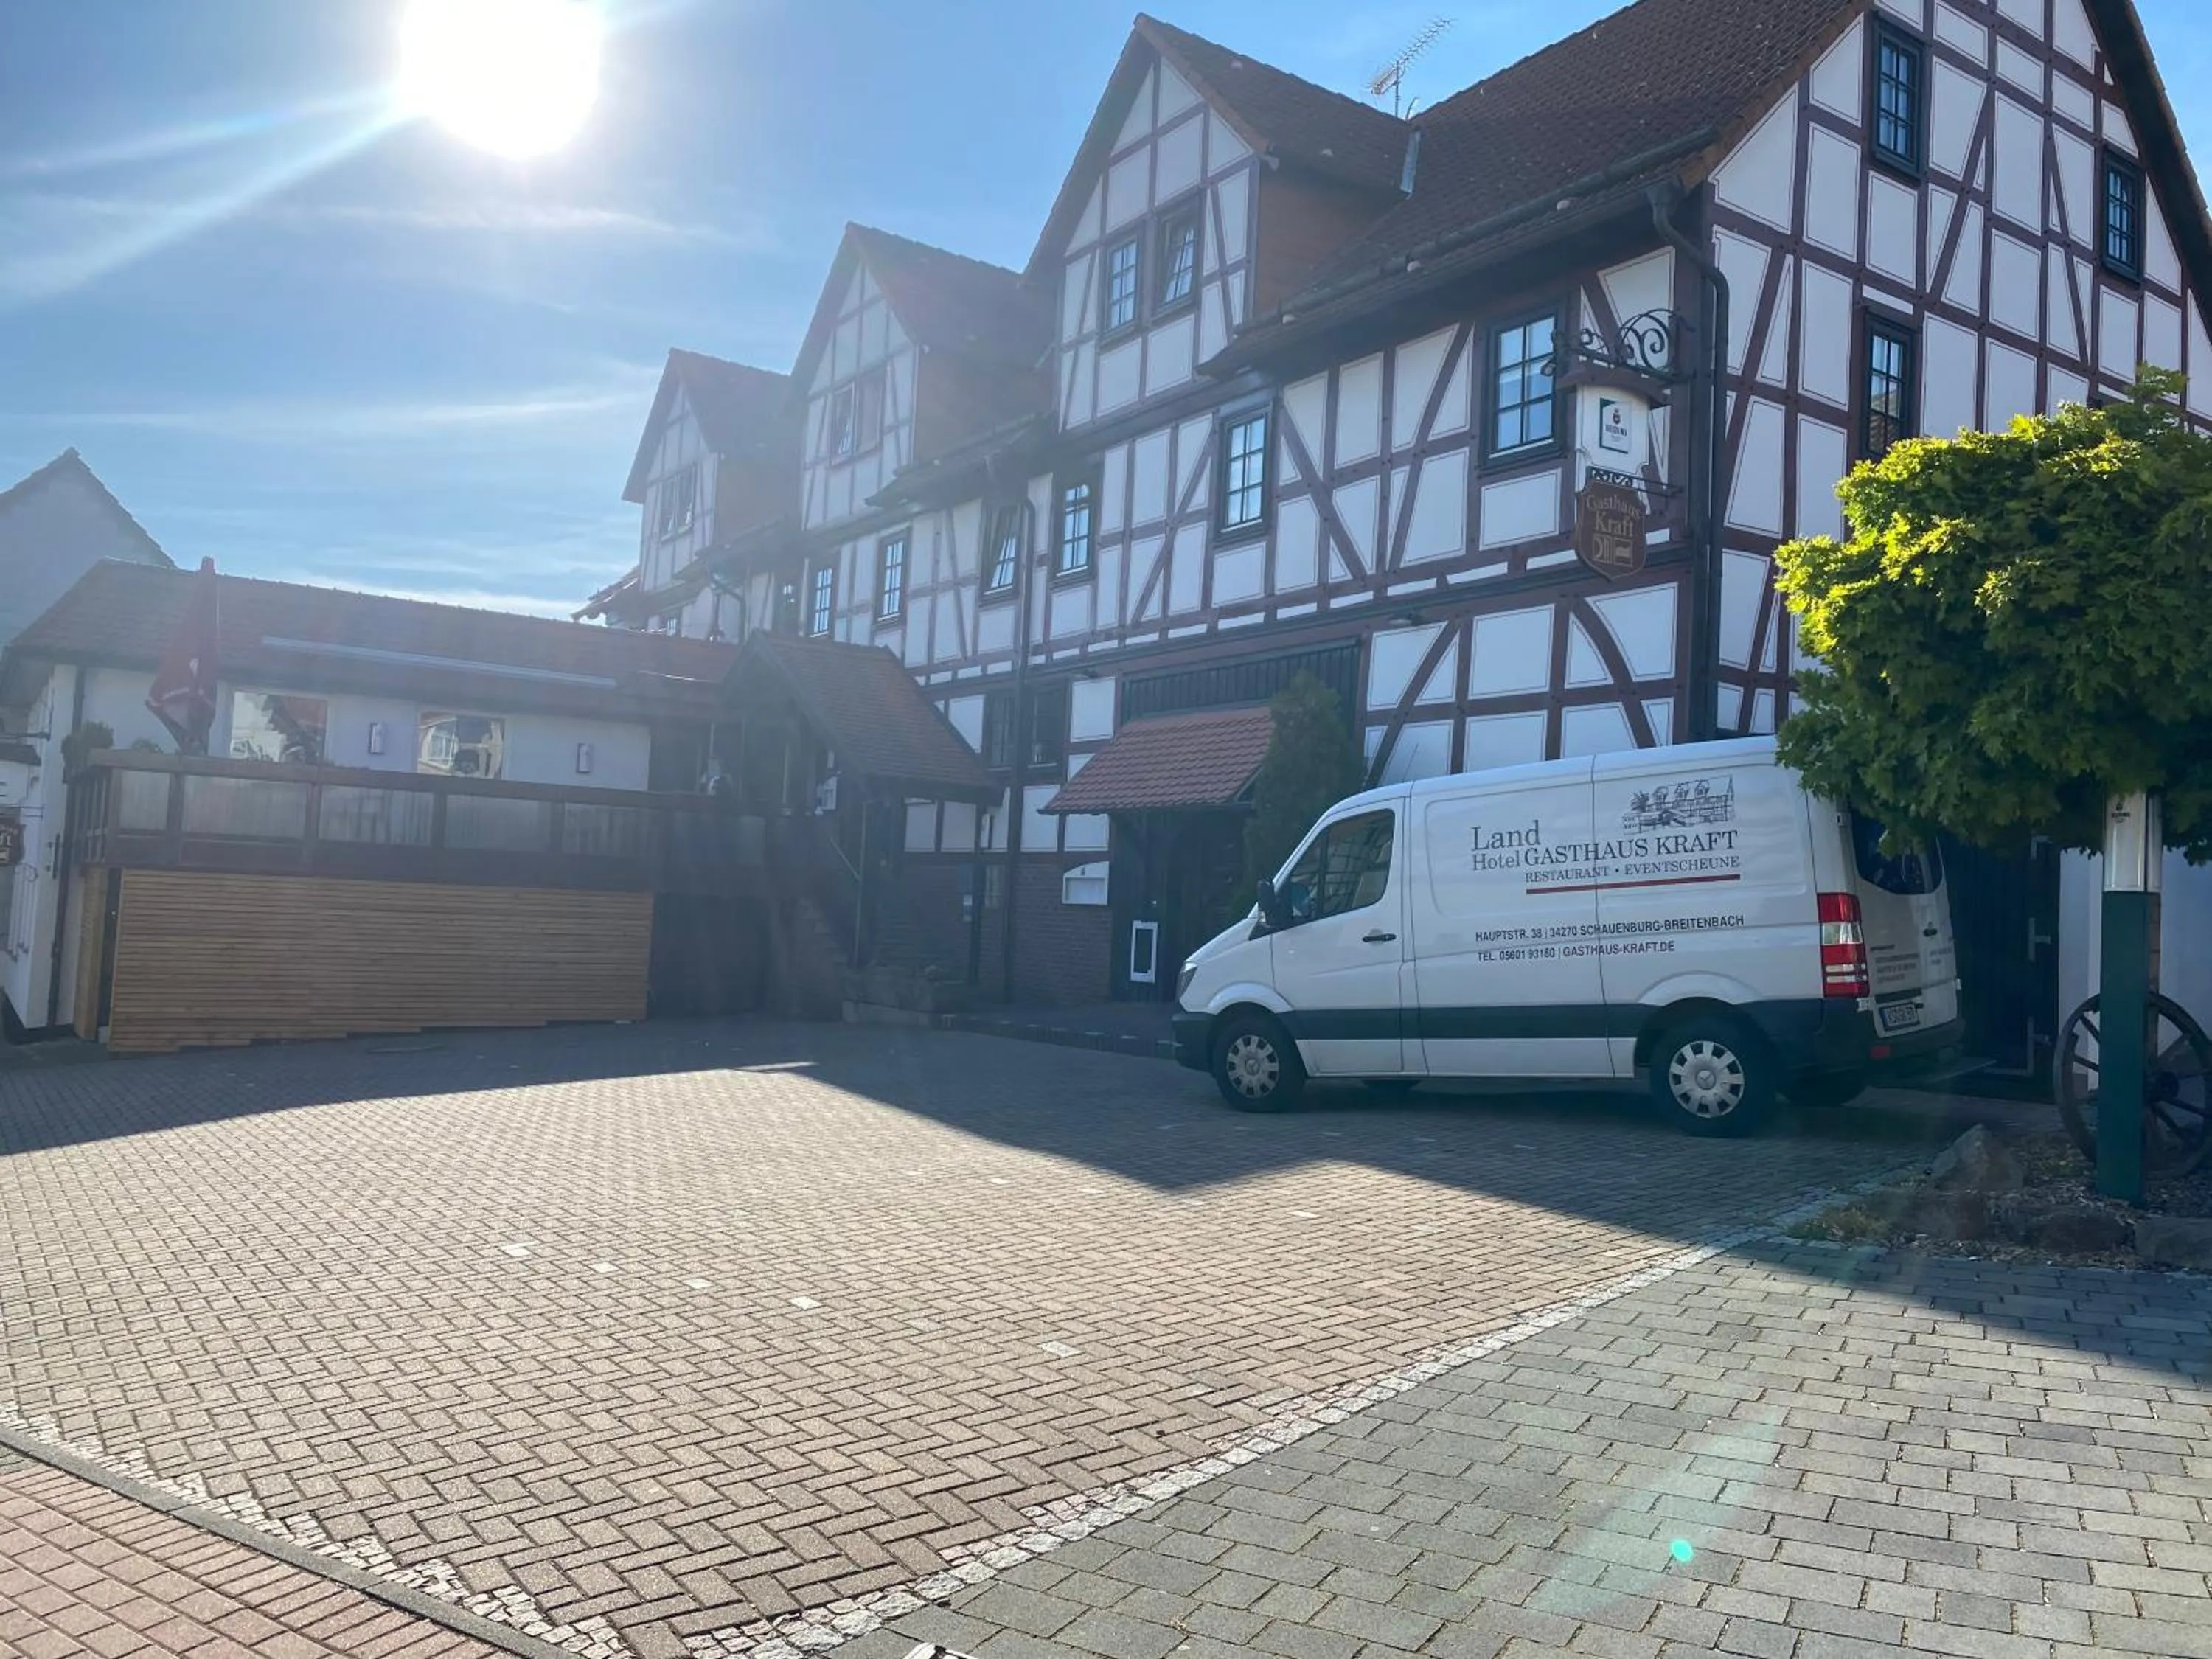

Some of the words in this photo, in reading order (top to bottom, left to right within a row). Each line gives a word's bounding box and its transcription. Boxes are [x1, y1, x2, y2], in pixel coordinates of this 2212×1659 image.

[1595, 510, 1634, 537] Kraft
[1471, 819, 1540, 852] Land
[1472, 850, 1520, 871] Hotel
[1524, 838, 1649, 866] GASTHAUS
[1655, 830, 1739, 856] KRAFT
[1525, 866, 1609, 883] RESTAURANT
[1624, 855, 1740, 875] EVENTSCHEUNE
[1475, 929, 1528, 942] HAUPTSTR.
[1531, 928, 1543, 939] 38
[1550, 926, 1578, 937] 34270
[1580, 915, 1744, 936] SCHAUENBURG-BREITENBACH
[1499, 950, 1526, 961] 05601
[1562, 940, 1675, 957] GASTHAUS-KRAFT.DE
